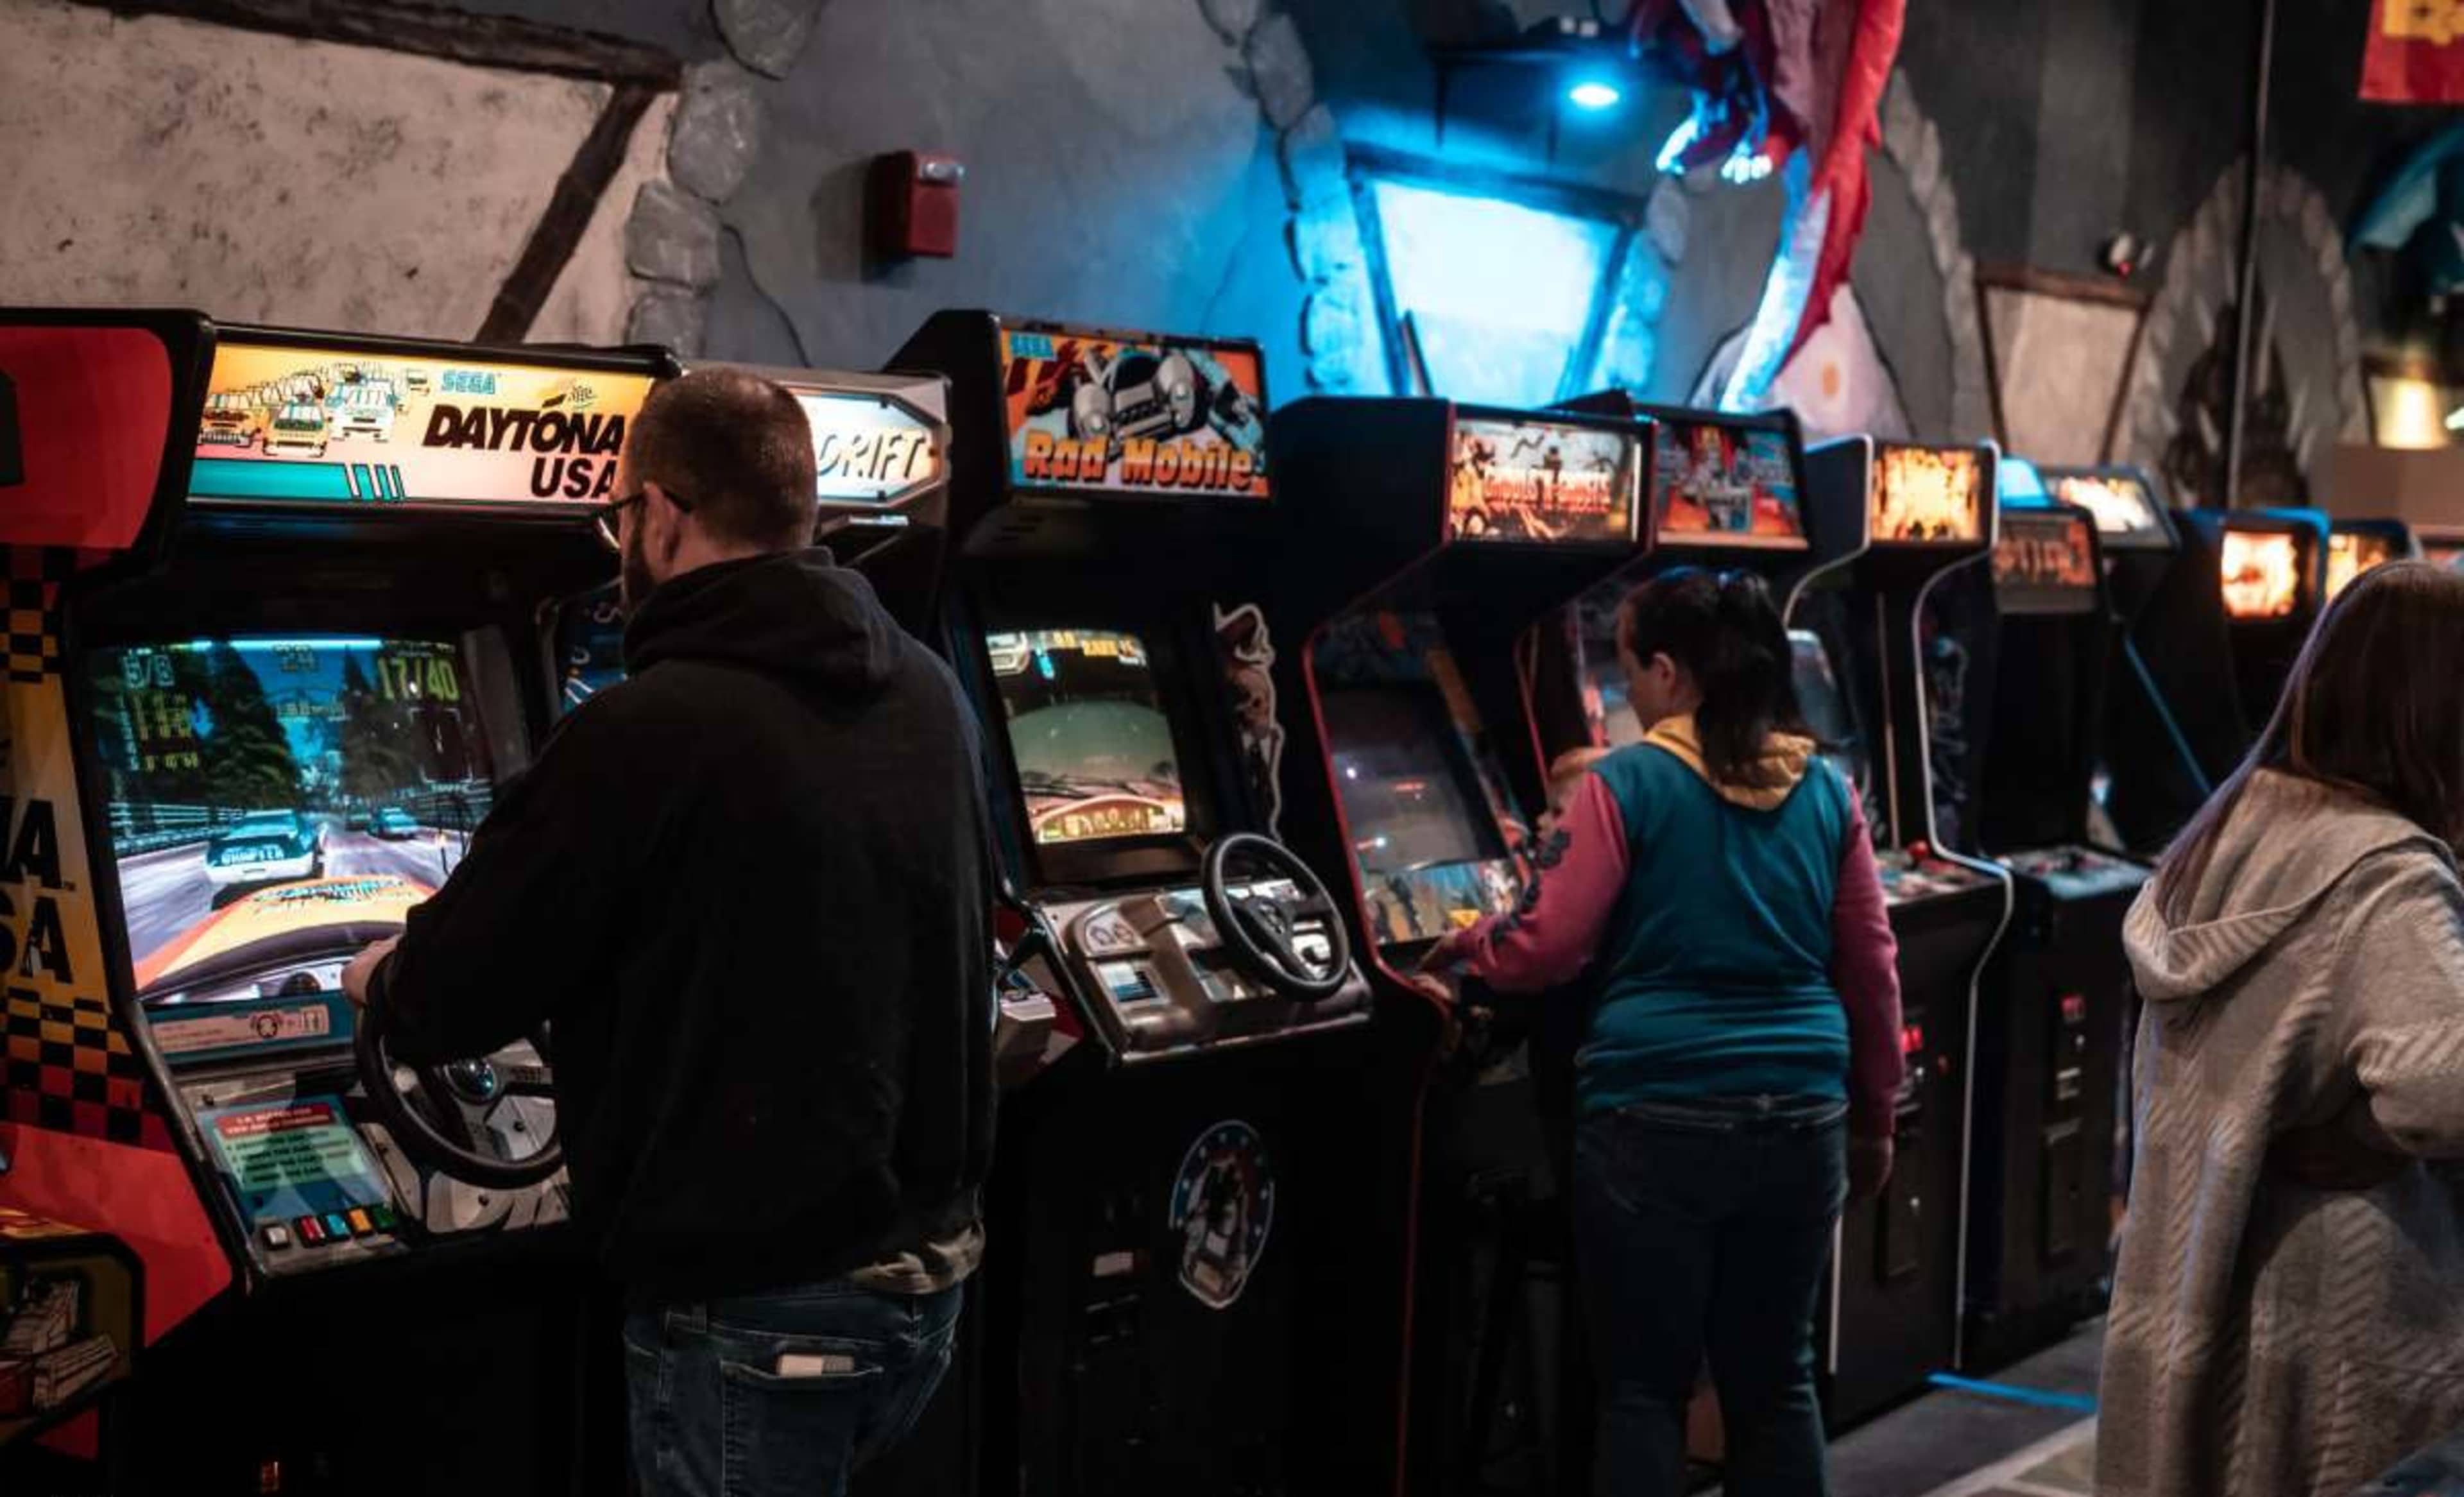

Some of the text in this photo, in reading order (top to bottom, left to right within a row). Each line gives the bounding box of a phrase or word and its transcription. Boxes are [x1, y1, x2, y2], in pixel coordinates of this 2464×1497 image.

[441, 369, 495, 395] SEGA
[422, 404, 625, 456] DAYTONA
[817, 431, 928, 481] DRIFT
[1024, 428, 1253, 492] Rad Mobile
[378, 656, 460, 701] 17/40
